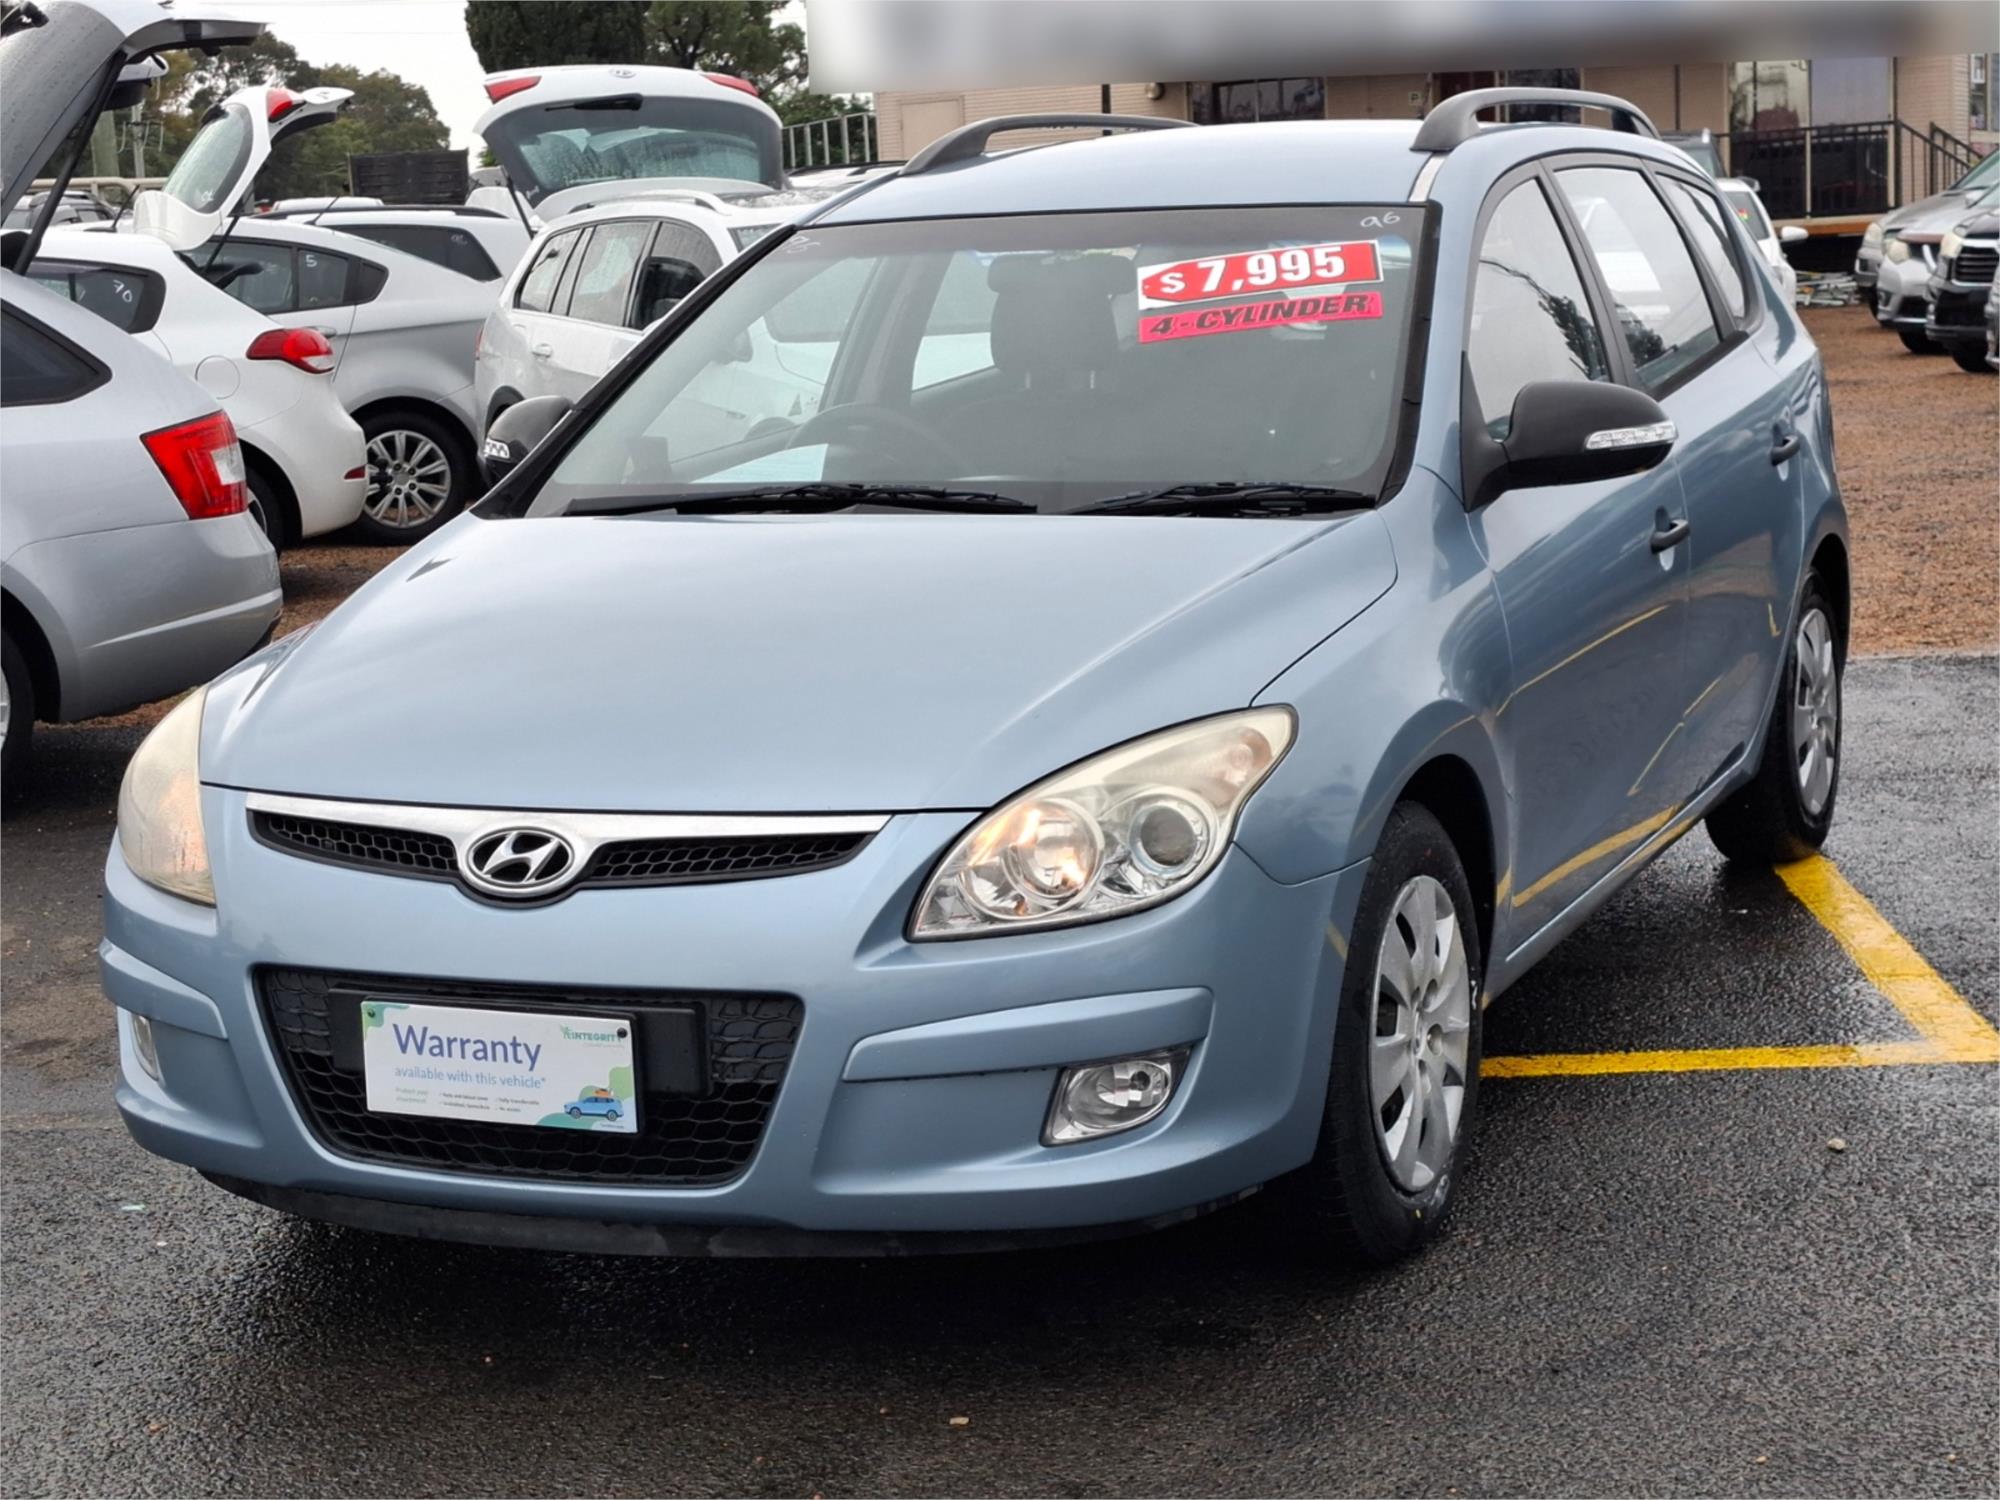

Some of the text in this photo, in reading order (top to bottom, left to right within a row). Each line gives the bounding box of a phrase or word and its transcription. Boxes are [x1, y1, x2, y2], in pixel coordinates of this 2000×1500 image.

[1151, 294, 1372, 336] 4-CYLINDER
[392, 1023, 542, 1072] Warranty
[395, 1065, 444, 1081] available
[446, 1069, 473, 1083] with
[475, 1071, 497, 1086] this
